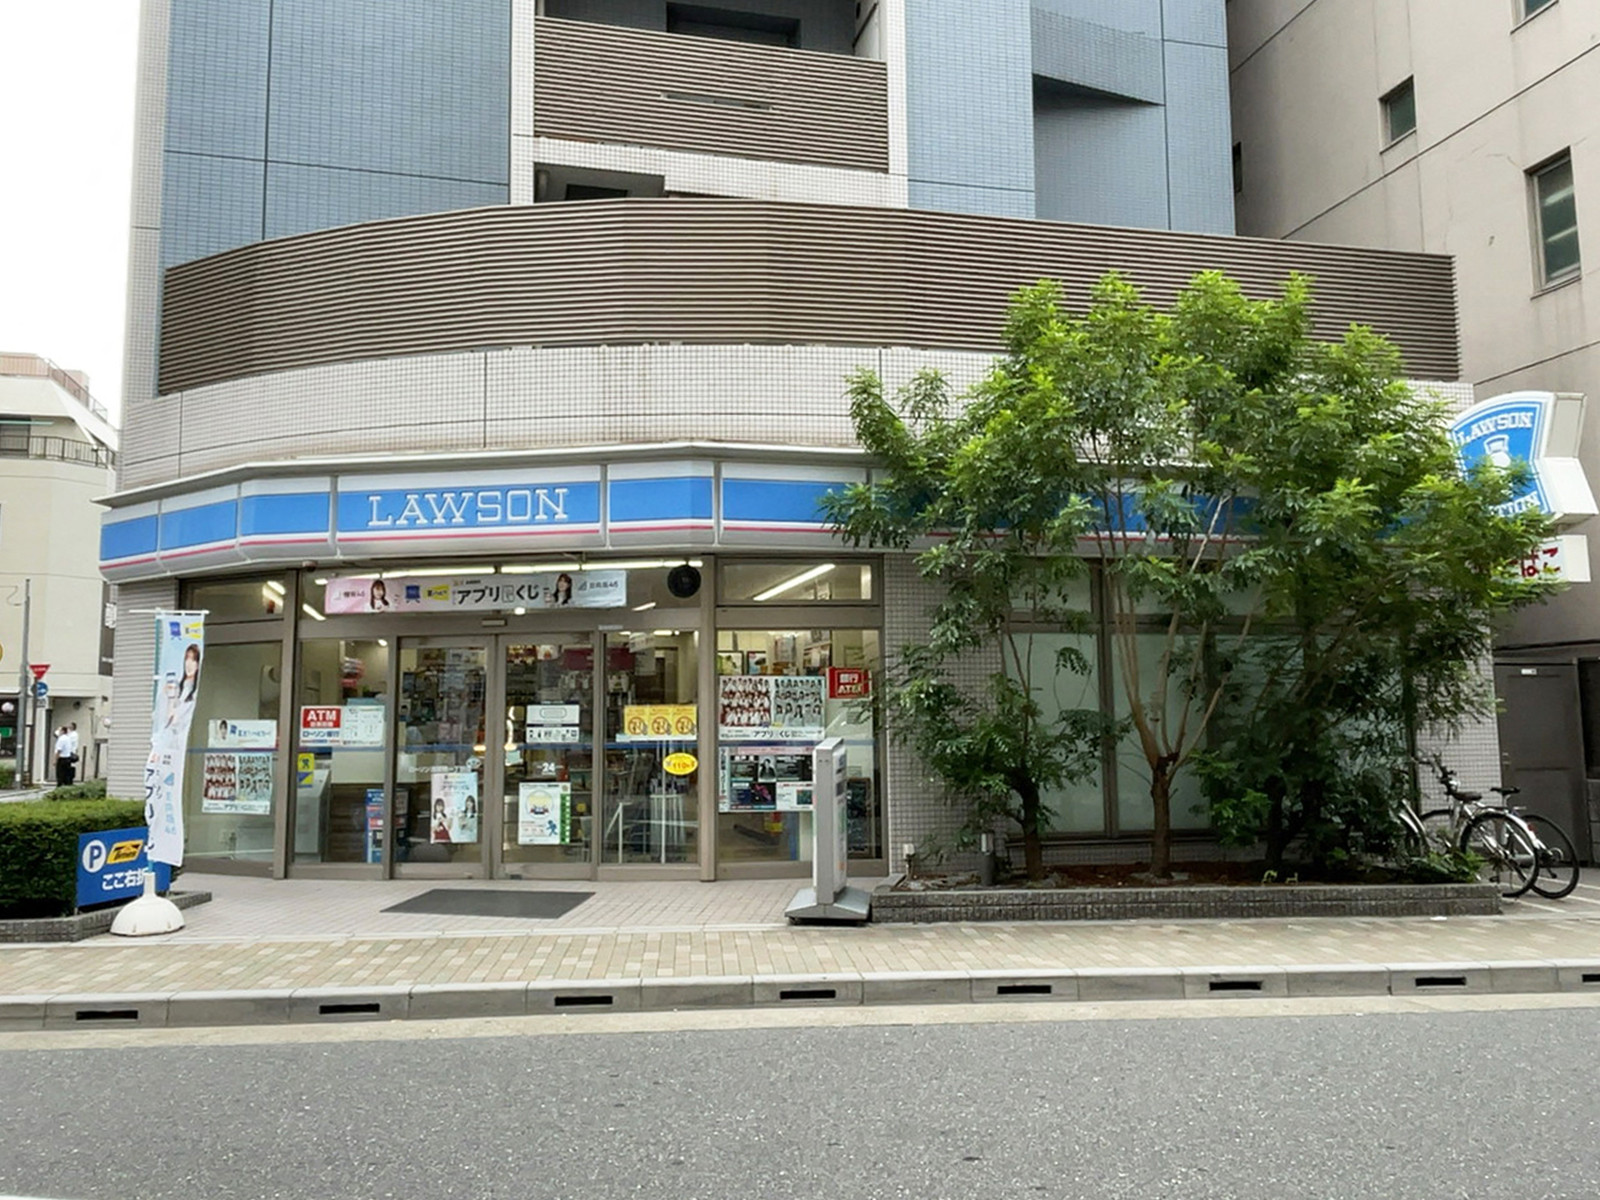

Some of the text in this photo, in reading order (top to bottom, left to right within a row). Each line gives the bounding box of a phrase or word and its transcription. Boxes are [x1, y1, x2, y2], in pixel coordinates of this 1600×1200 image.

[1457, 412, 1534, 446] LAWSON
[368, 488, 568, 526] LAWSON
[457, 585, 500, 605] アプリ
[516, 584, 539, 601] くじ
[307, 709, 337, 721] ATM
[89, 845, 102, 869] P
